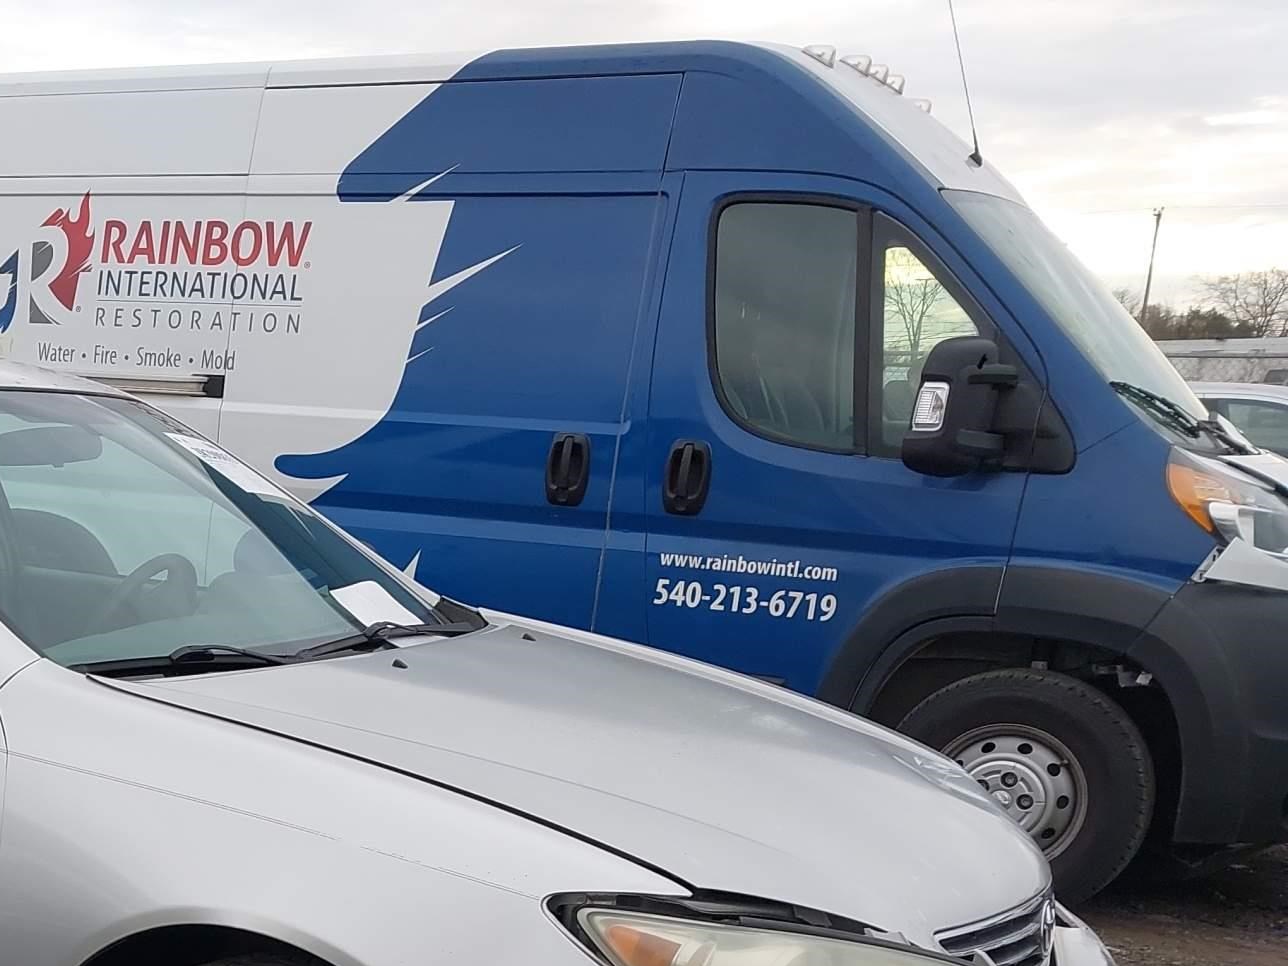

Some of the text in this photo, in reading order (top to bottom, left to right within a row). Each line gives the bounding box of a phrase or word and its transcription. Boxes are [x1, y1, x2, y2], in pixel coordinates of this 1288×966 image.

[100, 219, 312, 269] RAINBOW
[97, 270, 303, 302] INTERNATIONAL
[95, 307, 301, 335] RESTORATION
[38, 342, 236, 372] Water Fire Smoke Mold
[660, 552, 838, 581] www.rainbowintl.com
[653, 578, 837, 622] 540-213-6719
